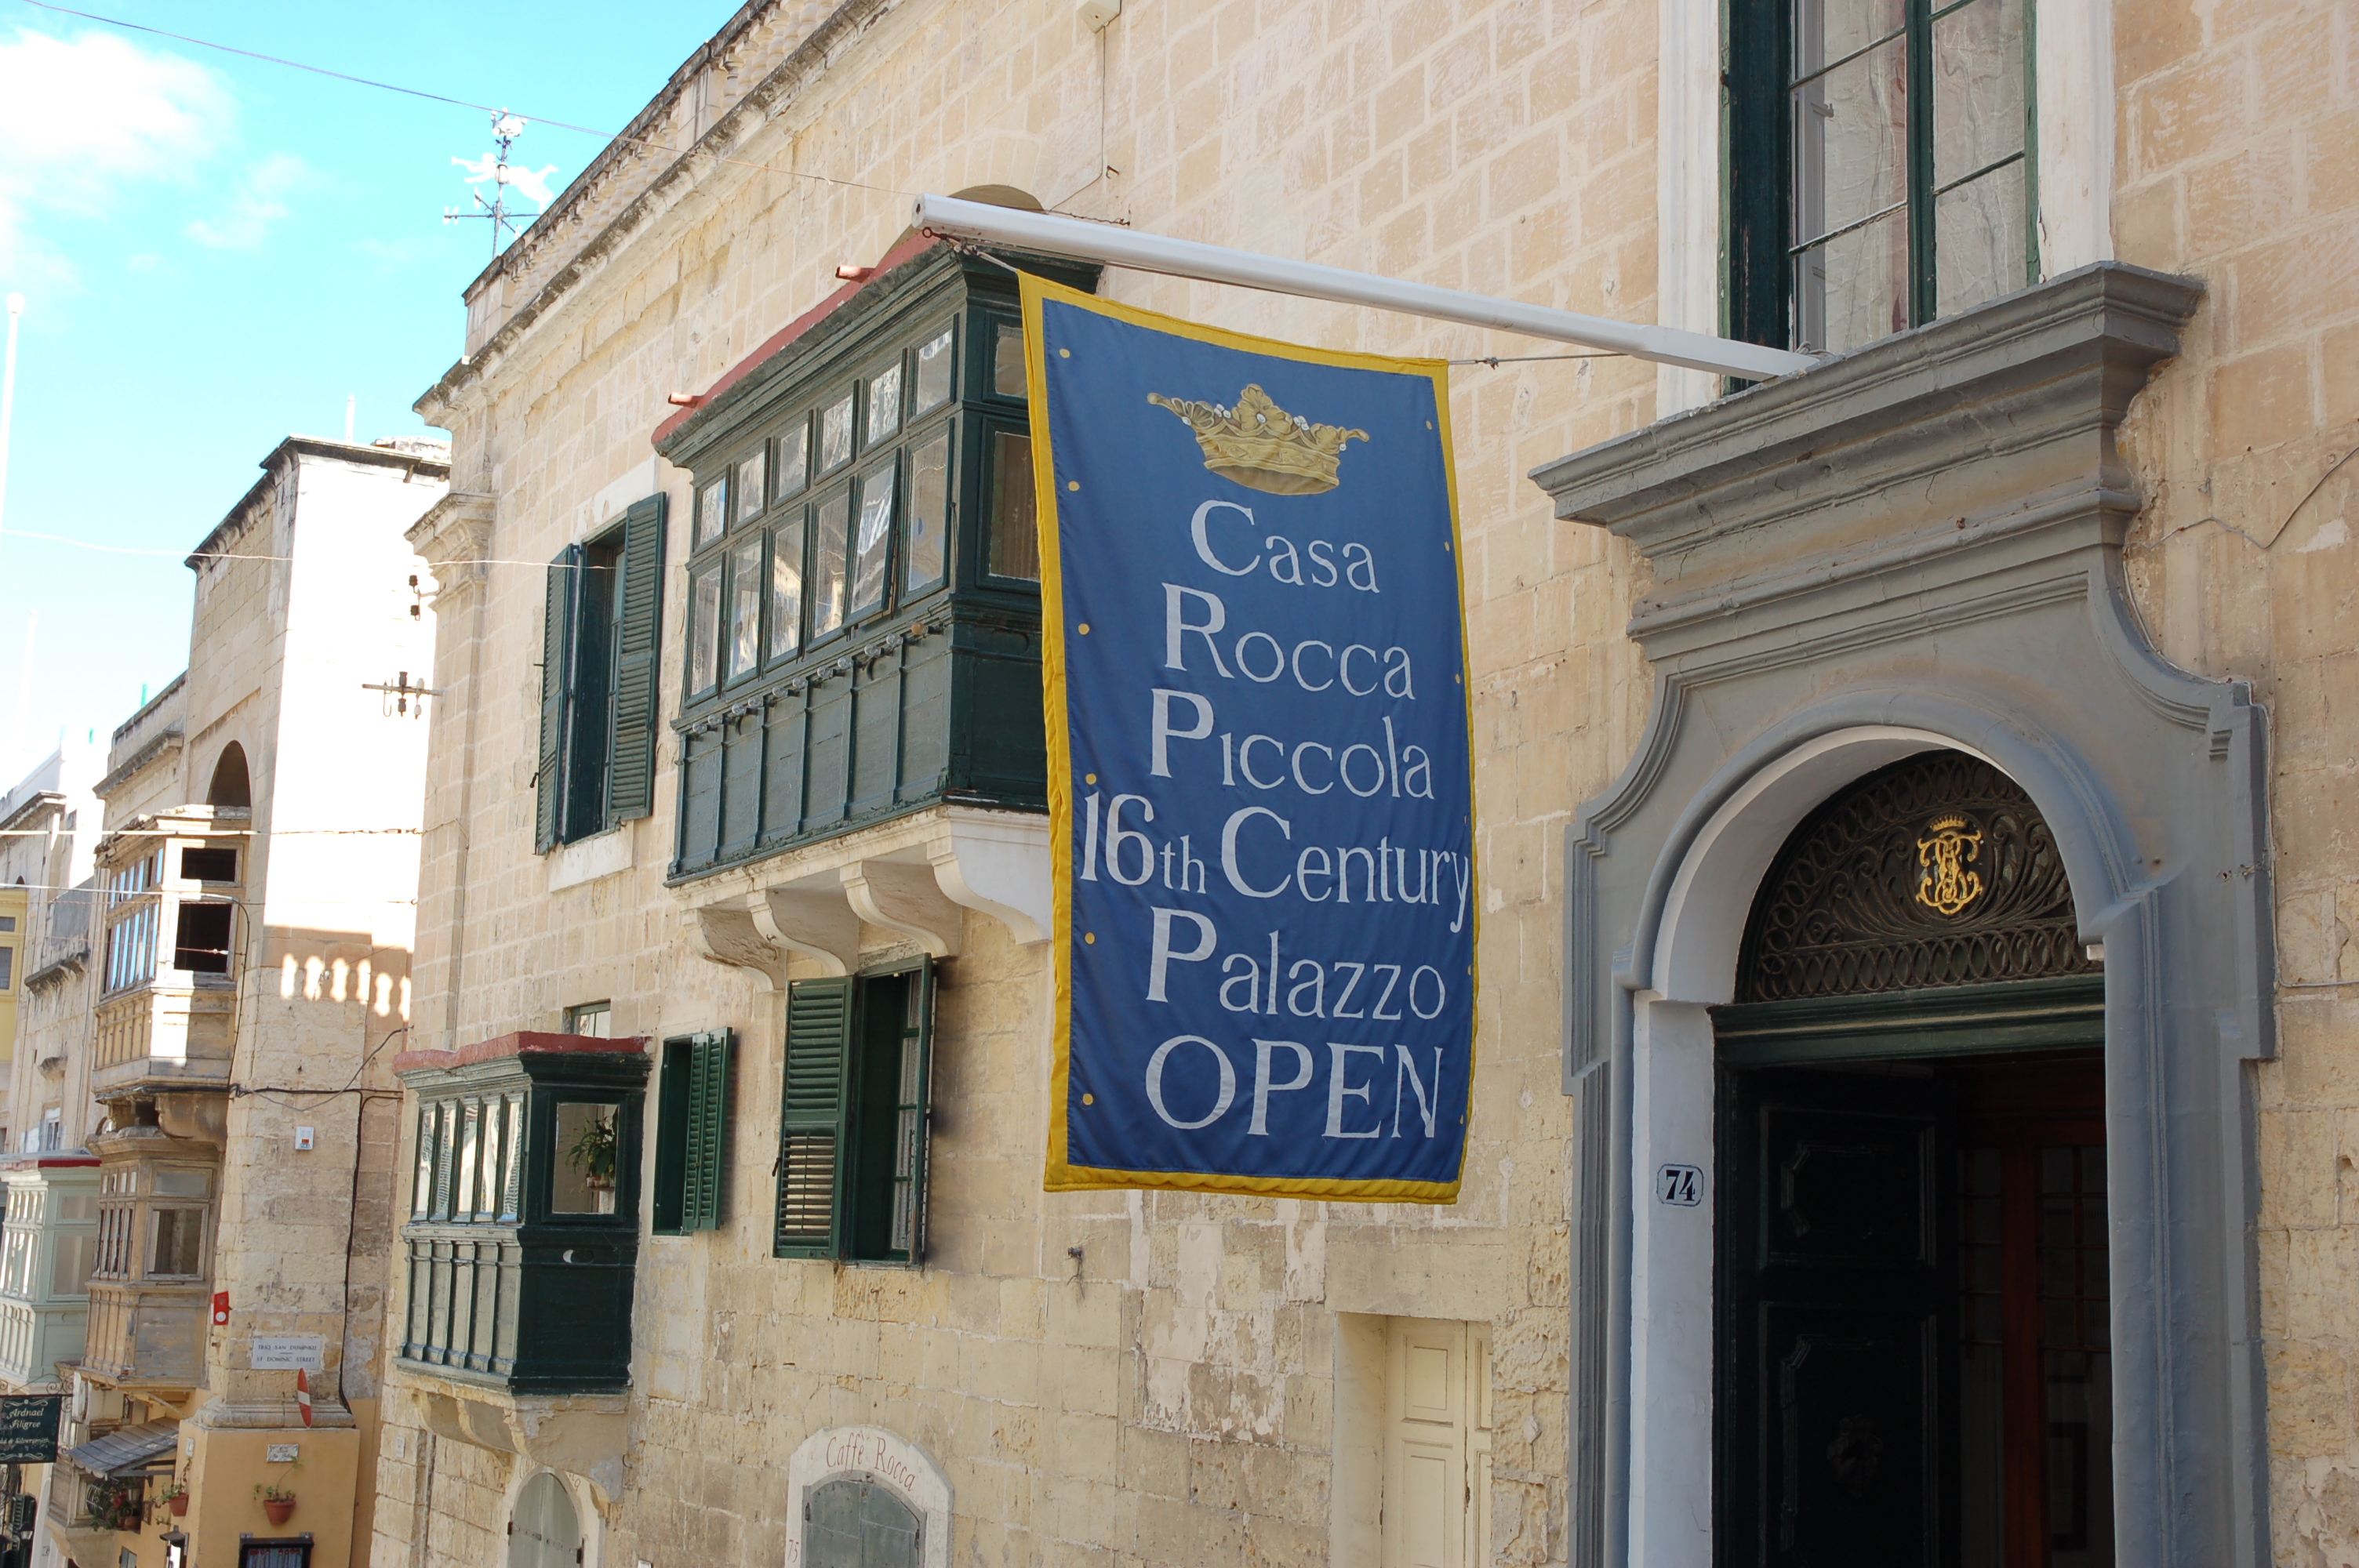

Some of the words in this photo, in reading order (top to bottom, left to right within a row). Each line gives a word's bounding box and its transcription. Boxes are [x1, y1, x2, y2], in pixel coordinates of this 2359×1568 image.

[1190, 499, 1380, 593] Casa
[1161, 582, 1416, 700] Rocca
[1150, 688, 1435, 800] Piccola
[1080, 790, 1207, 895] 16th
[1221, 806, 1470, 934] Century
[1146, 906, 1446, 1021] Palazzo
[1145, 1034, 1444, 1139] OPEN
[1665, 1169, 1696, 1202] 74
[874, 1436, 916, 1492] Rocca
[787, 1538, 800, 1563] 75
